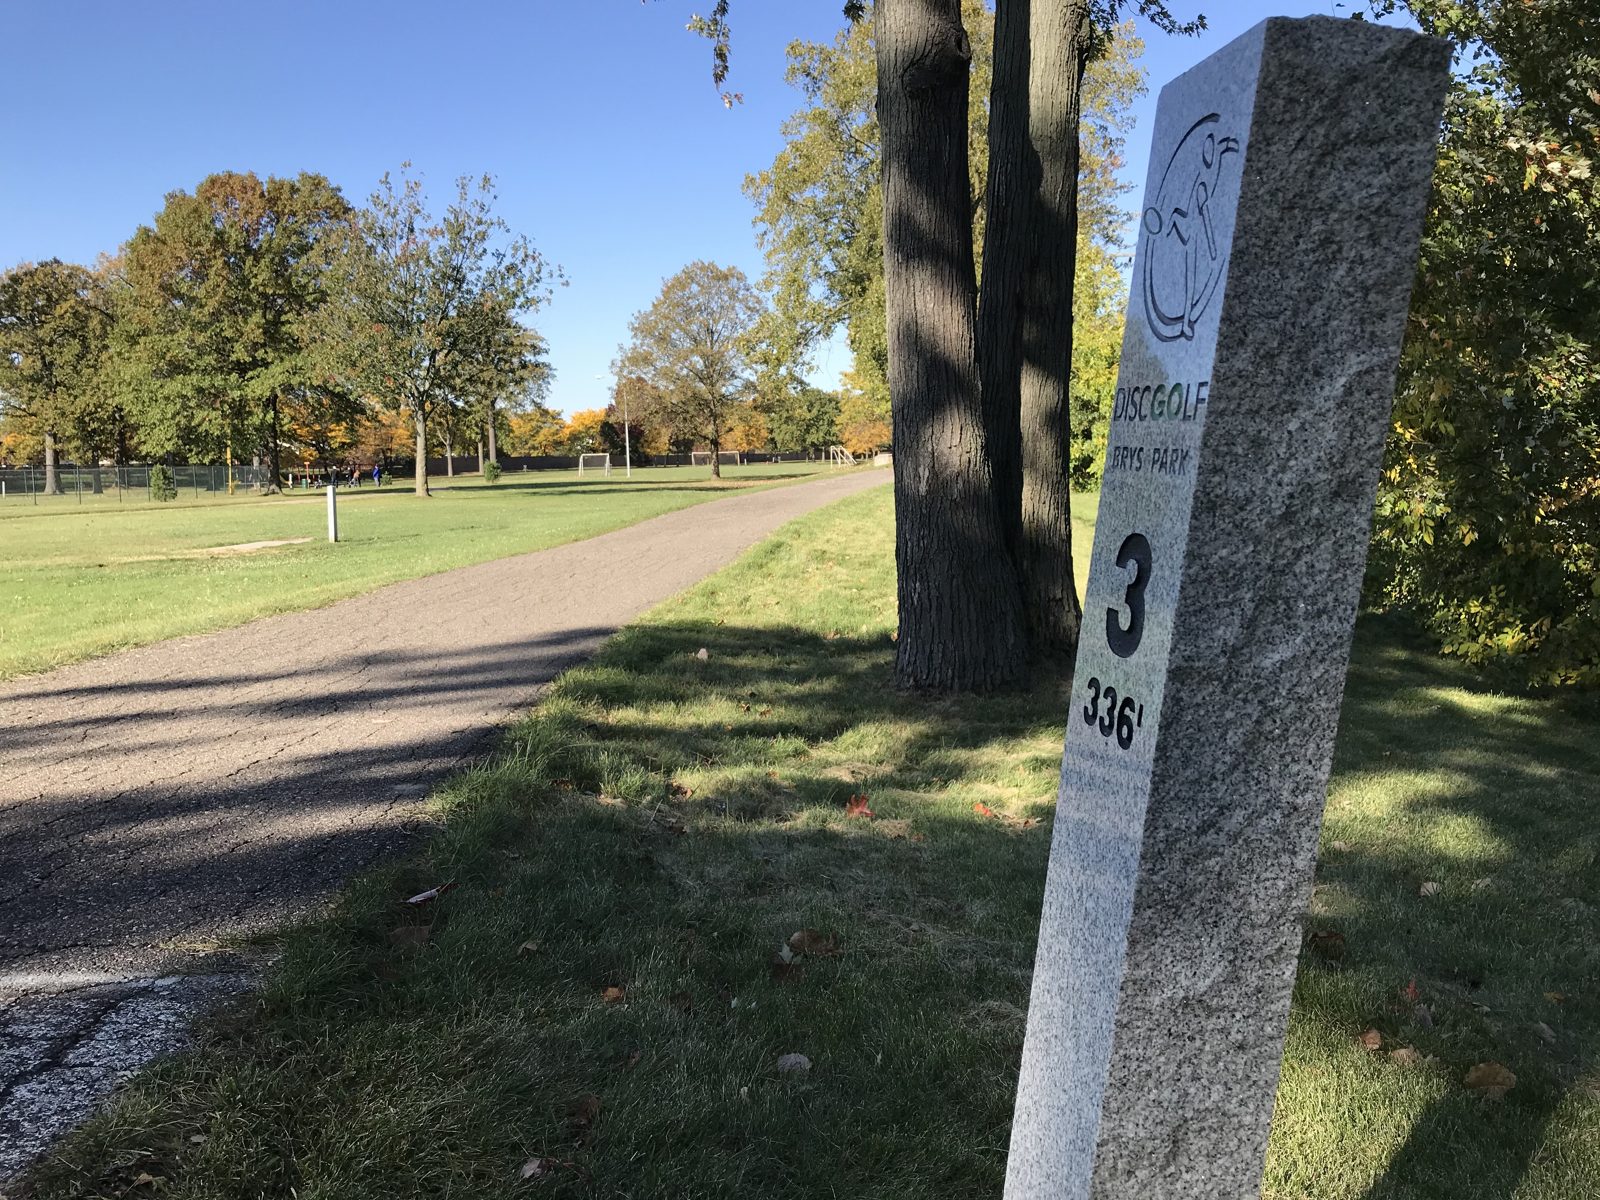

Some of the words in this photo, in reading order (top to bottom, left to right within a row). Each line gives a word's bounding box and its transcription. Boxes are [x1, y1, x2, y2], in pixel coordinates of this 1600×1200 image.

[1111, 446, 1144, 472] BRYS
[1151, 446, 1189, 476] PARK
[1106, 532, 1152, 658] 3
